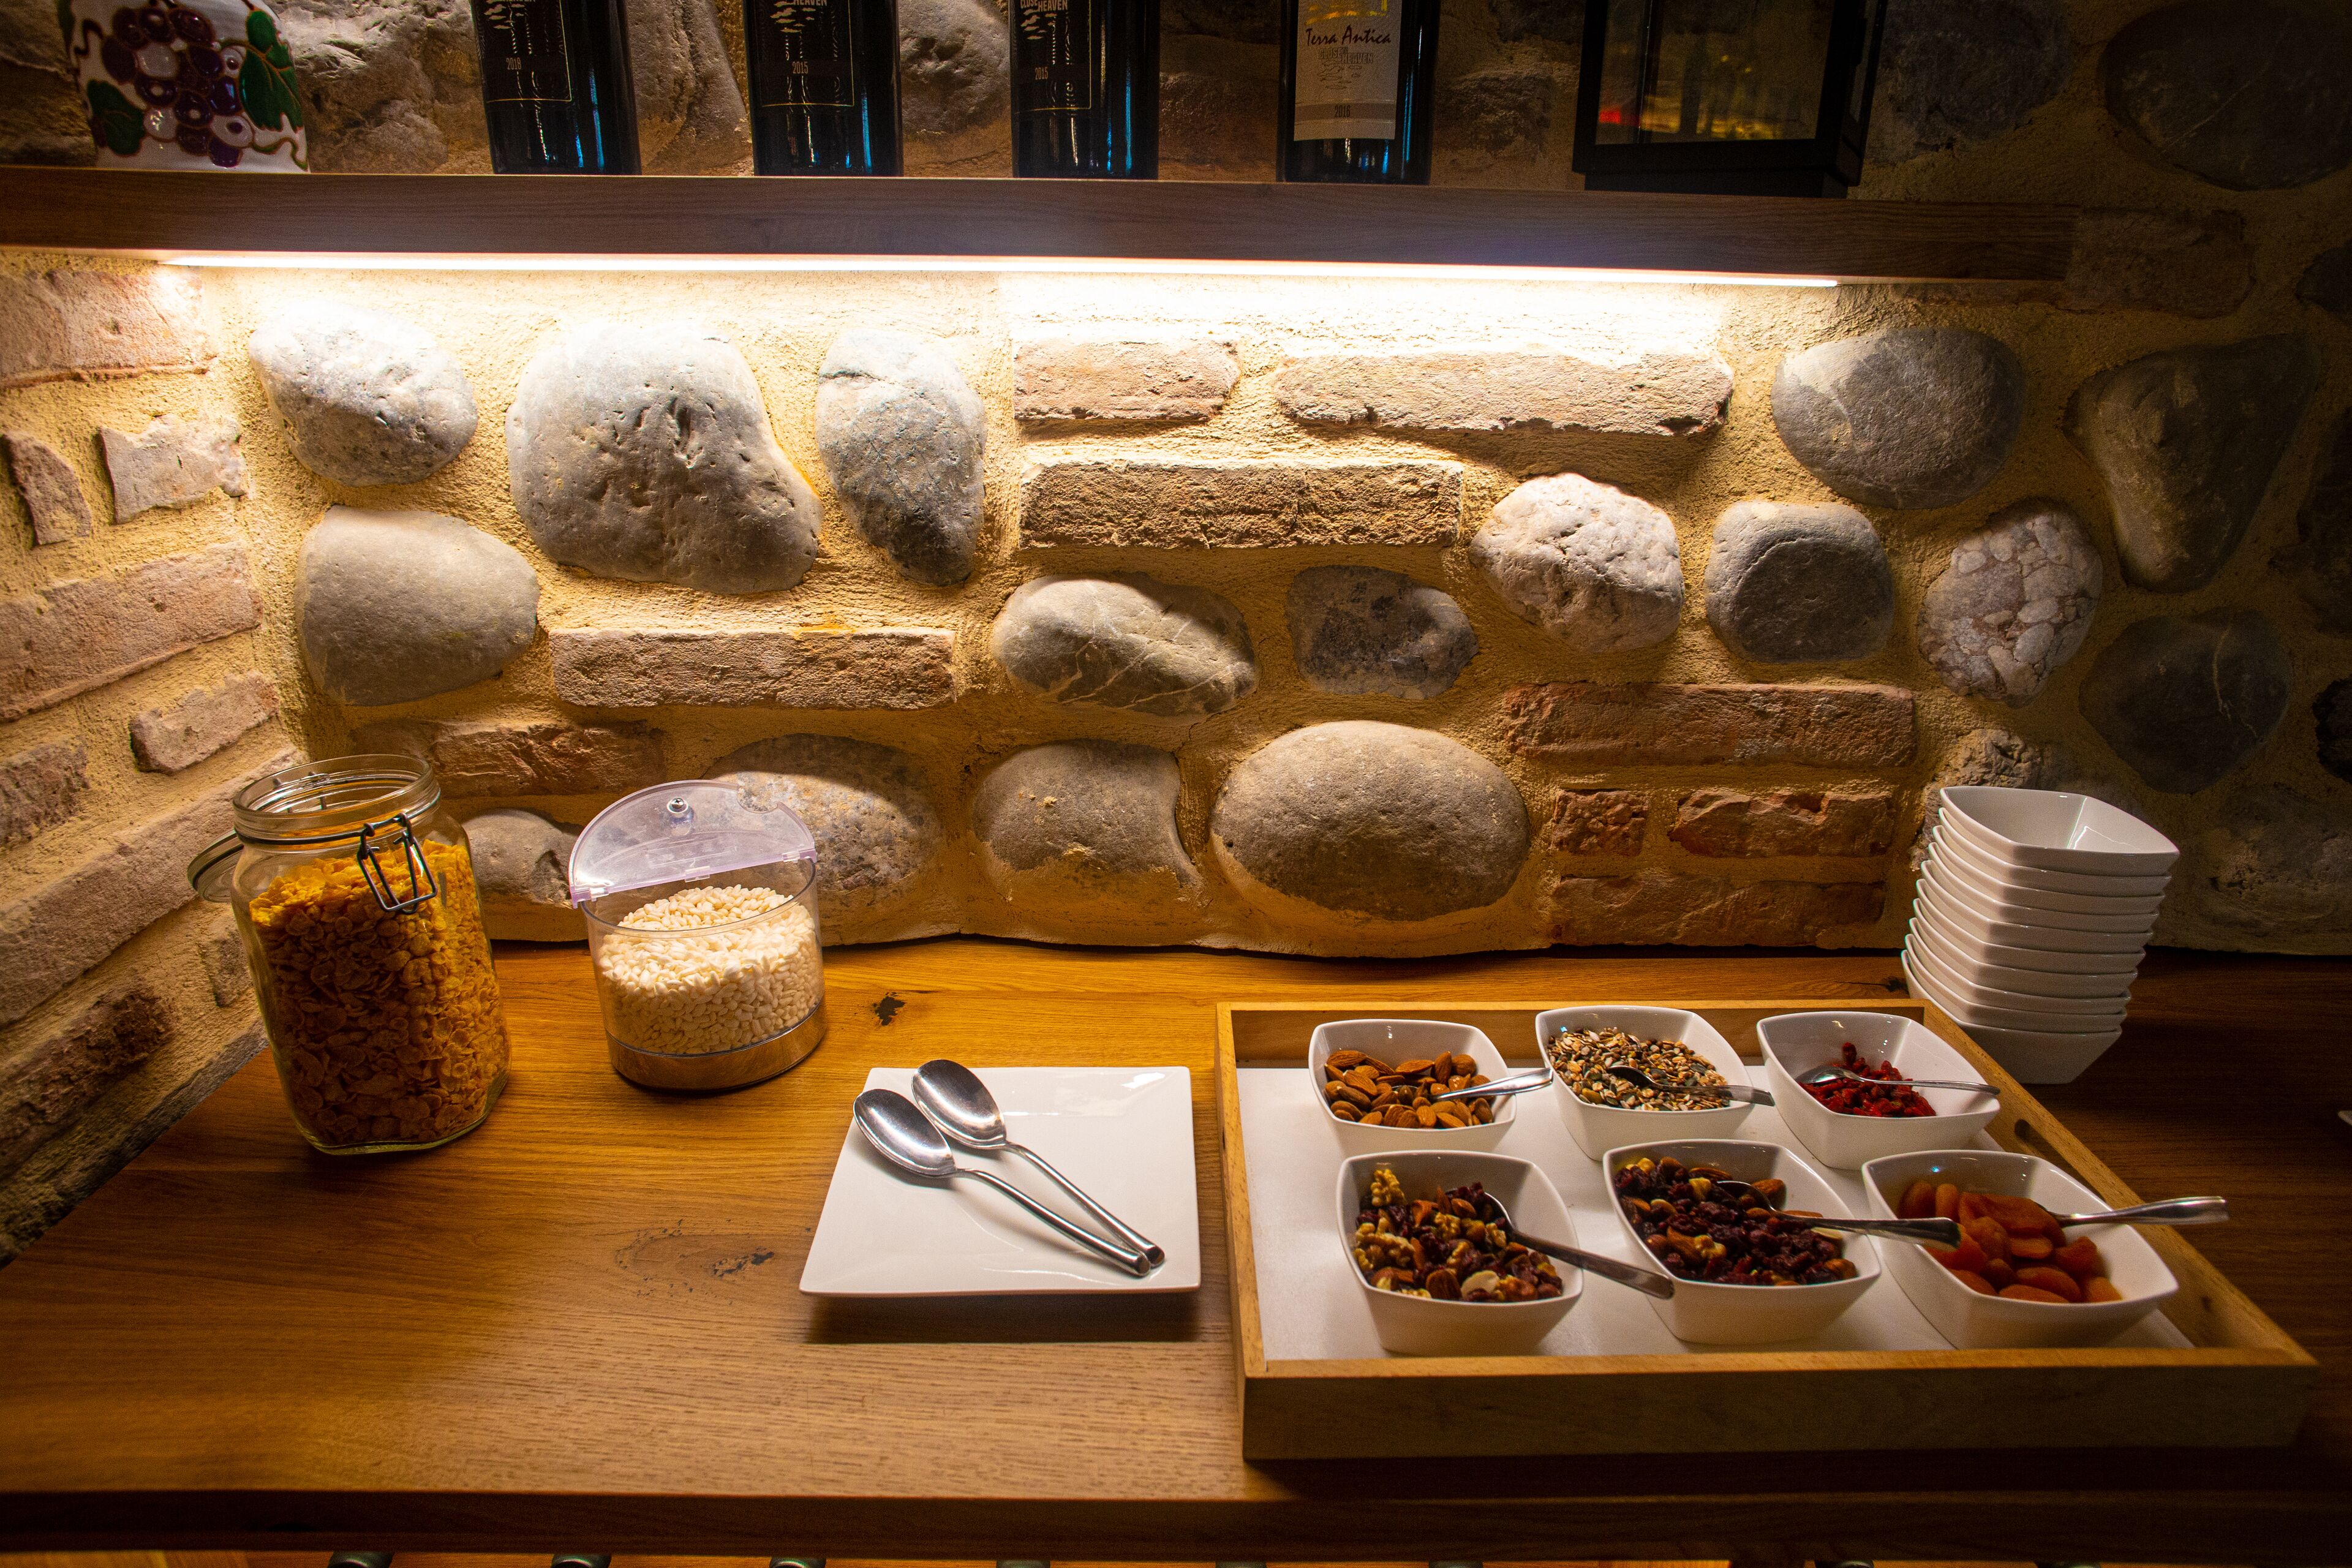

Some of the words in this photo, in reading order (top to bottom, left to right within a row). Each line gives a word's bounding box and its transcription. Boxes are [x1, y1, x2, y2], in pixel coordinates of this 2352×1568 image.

[1038, 0, 1068, 12] HEAVEN
[1306, 28, 1338, 47] Terra
[1341, 24, 1392, 45] Antica
[1341, 53, 1373, 64] HEAVEN
[793, 61, 809, 74] 2015
[1035, 67, 1048, 80] 2015
[1335, 105, 1351, 118] 2016
